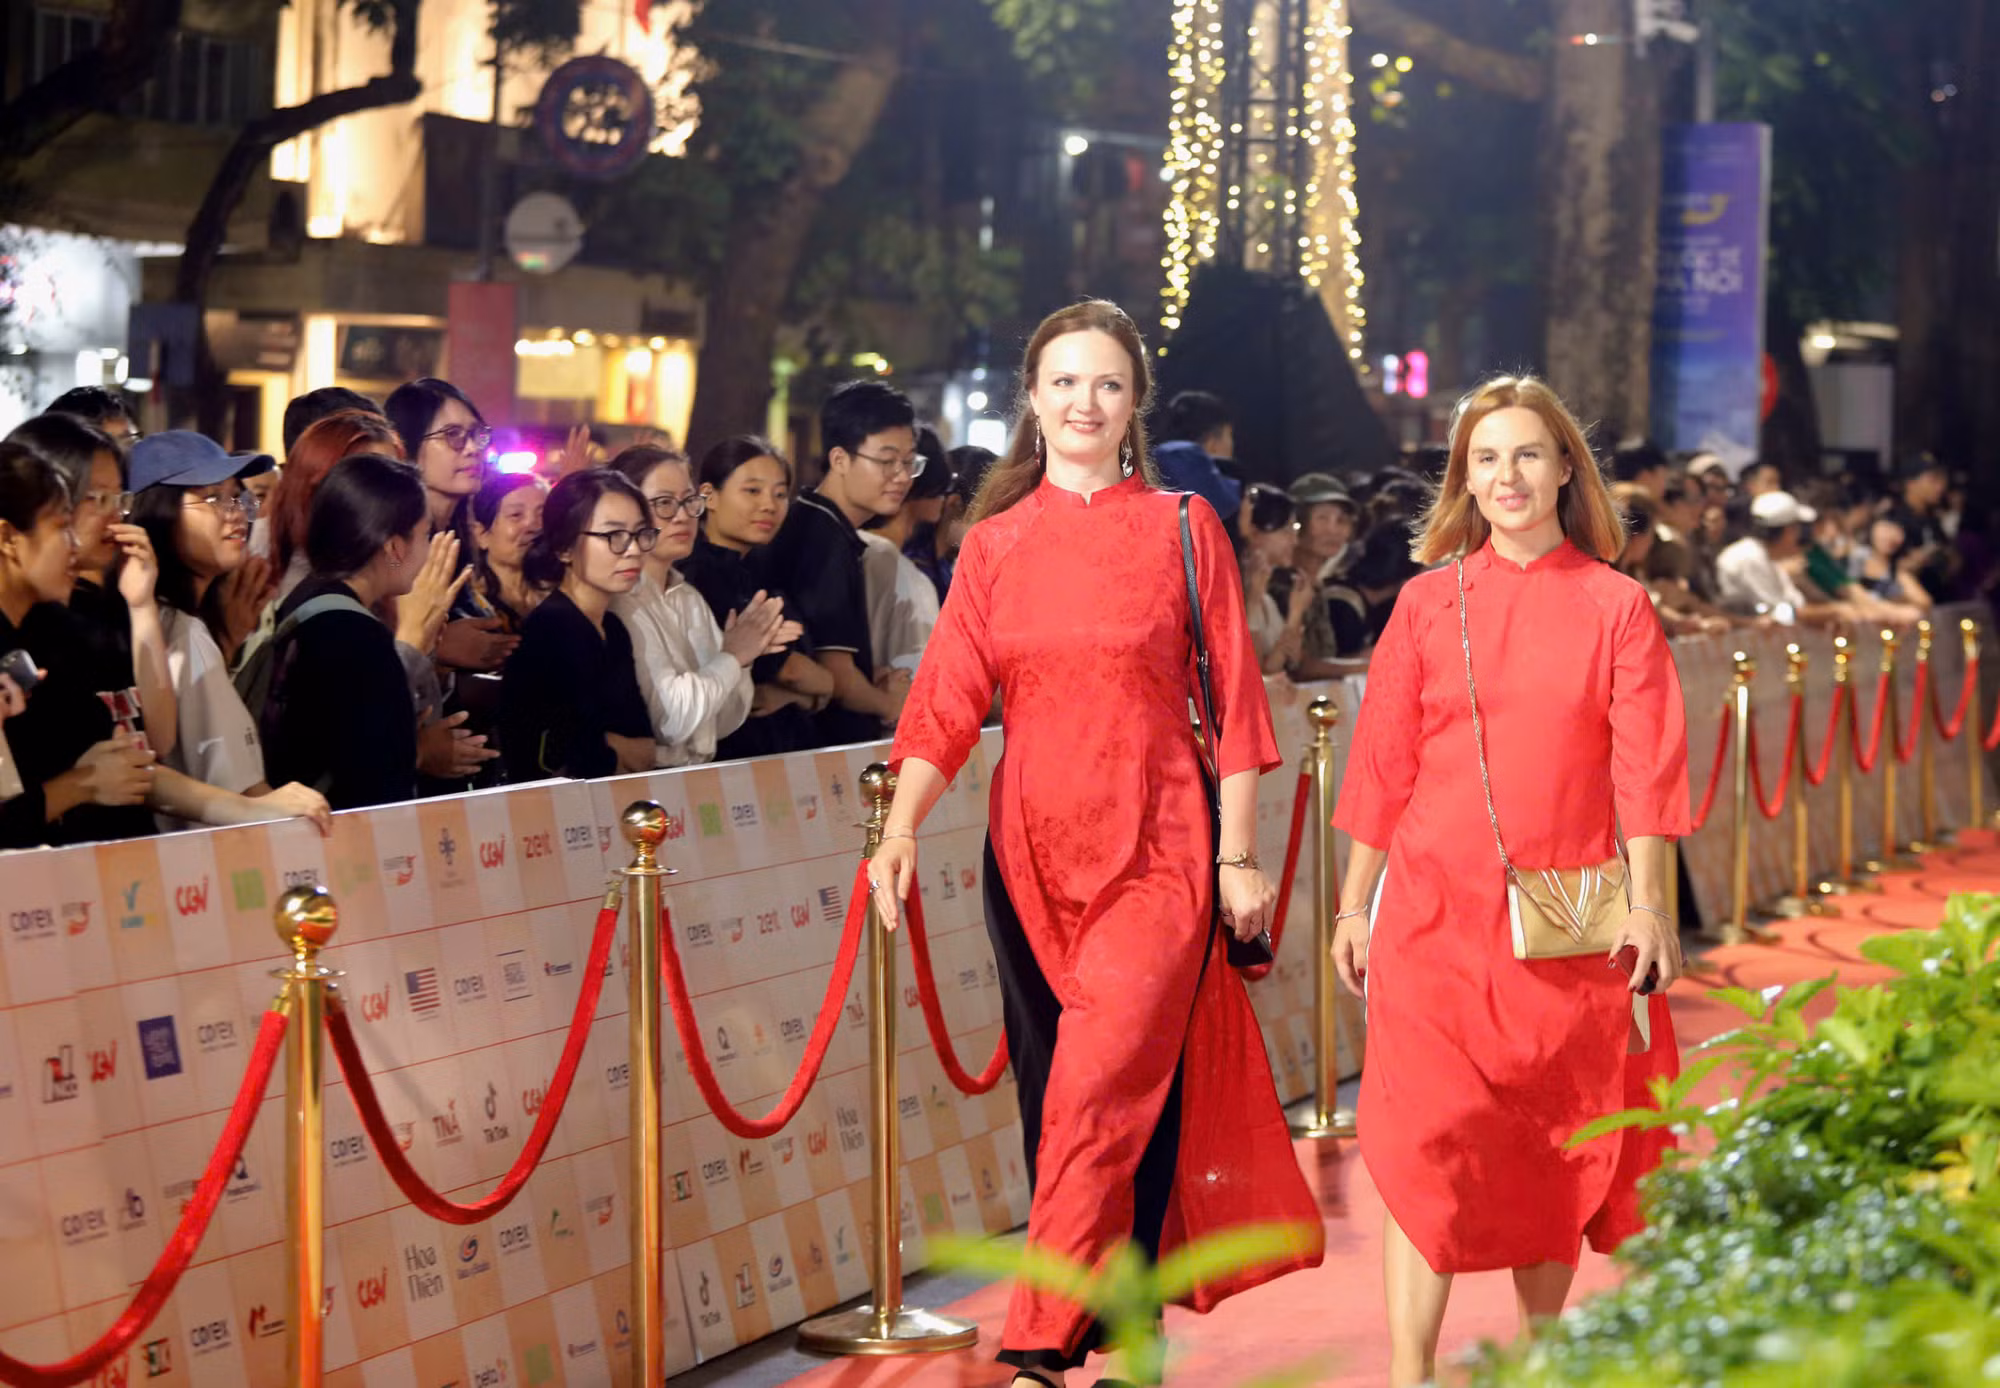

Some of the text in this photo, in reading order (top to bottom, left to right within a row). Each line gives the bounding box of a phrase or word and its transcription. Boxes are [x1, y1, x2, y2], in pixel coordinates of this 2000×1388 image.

[480, 837, 506, 868] CGV
[175, 876, 208, 916] CGV
[790, 902, 811, 928] CGV
[361, 983, 390, 1023] CGV
[607, 1064, 629, 1085] core
[357, 1267, 388, 1309] CGV
